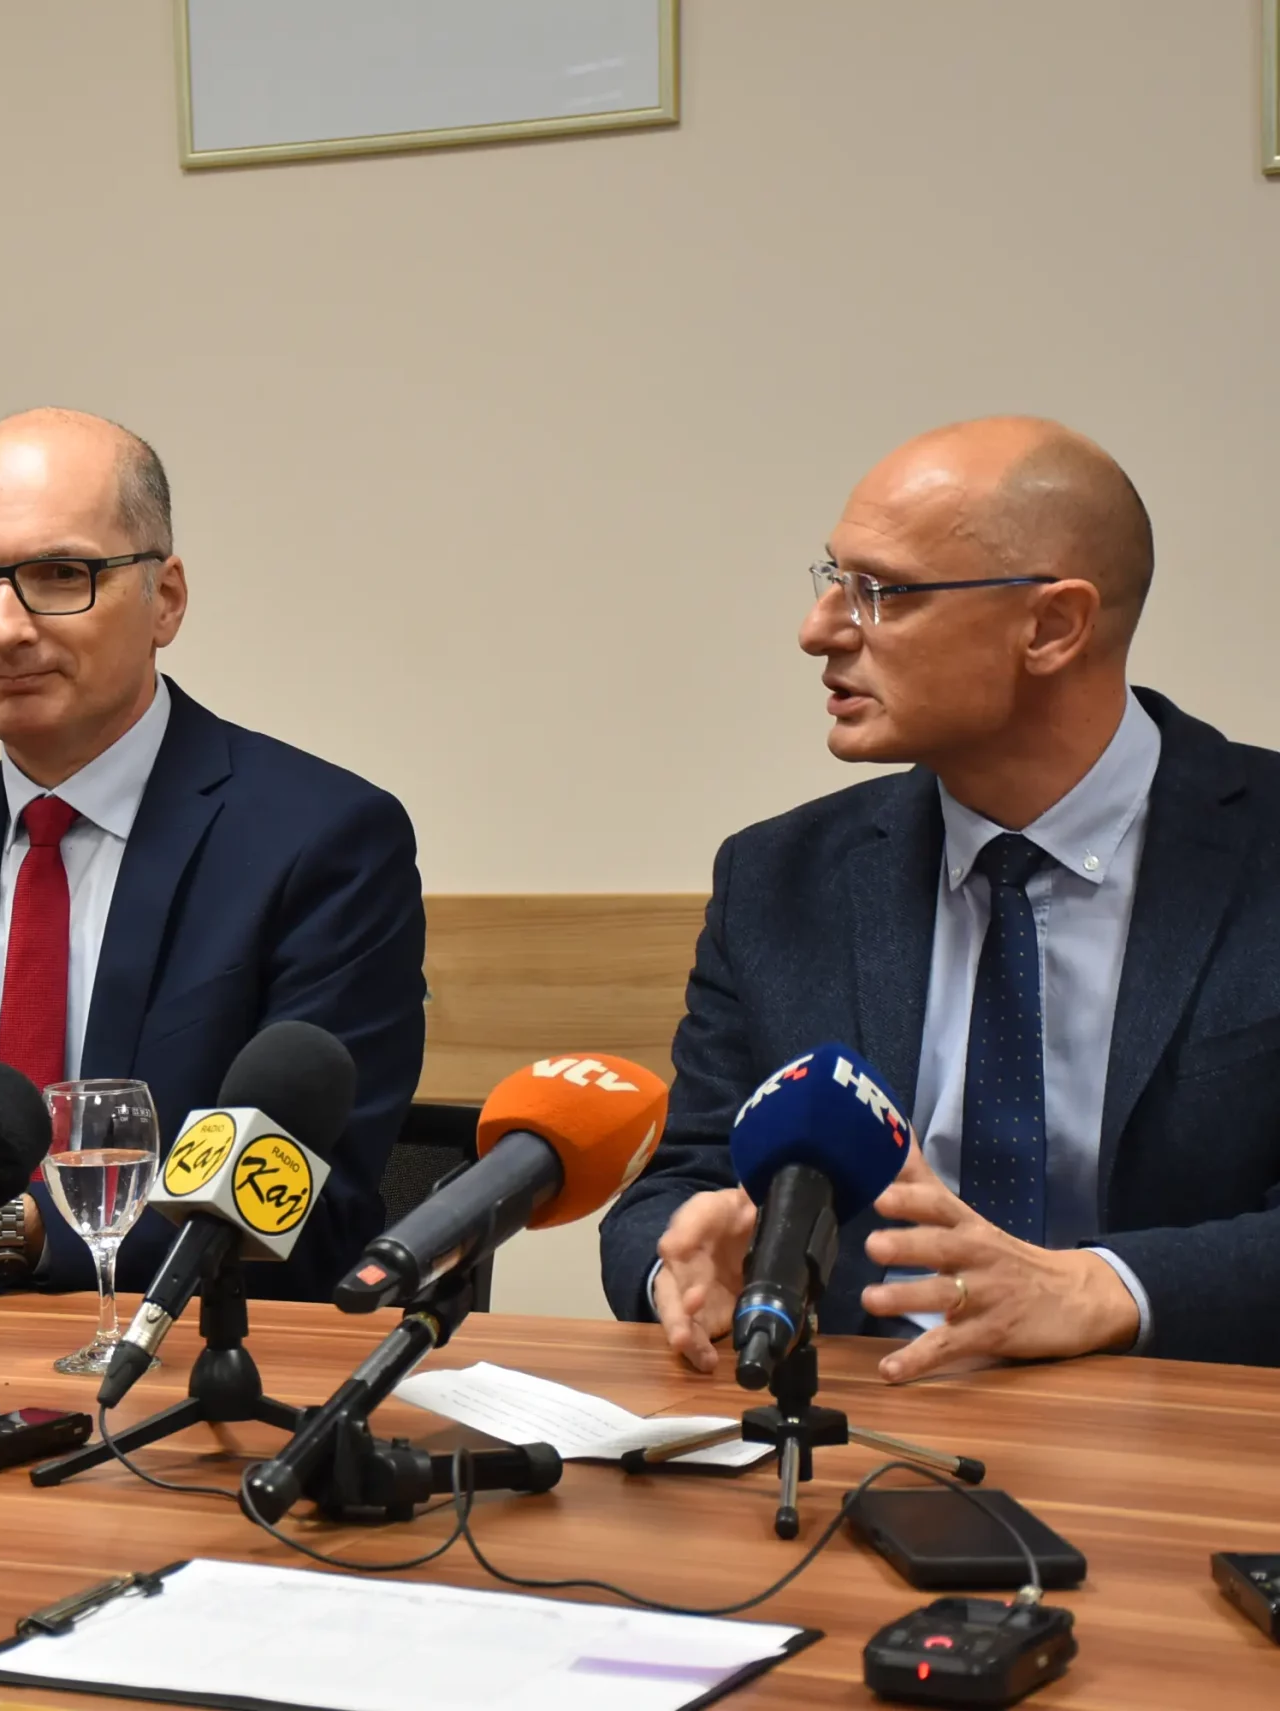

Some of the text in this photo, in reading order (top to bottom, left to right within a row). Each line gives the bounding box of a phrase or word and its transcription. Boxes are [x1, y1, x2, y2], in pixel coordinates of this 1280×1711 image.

[200, 1124, 225, 1133] RADIO
[167, 1136, 232, 1180] Kaj
[271, 1146, 300, 1173] RADIO
[236, 1155, 308, 1226] Kaj
